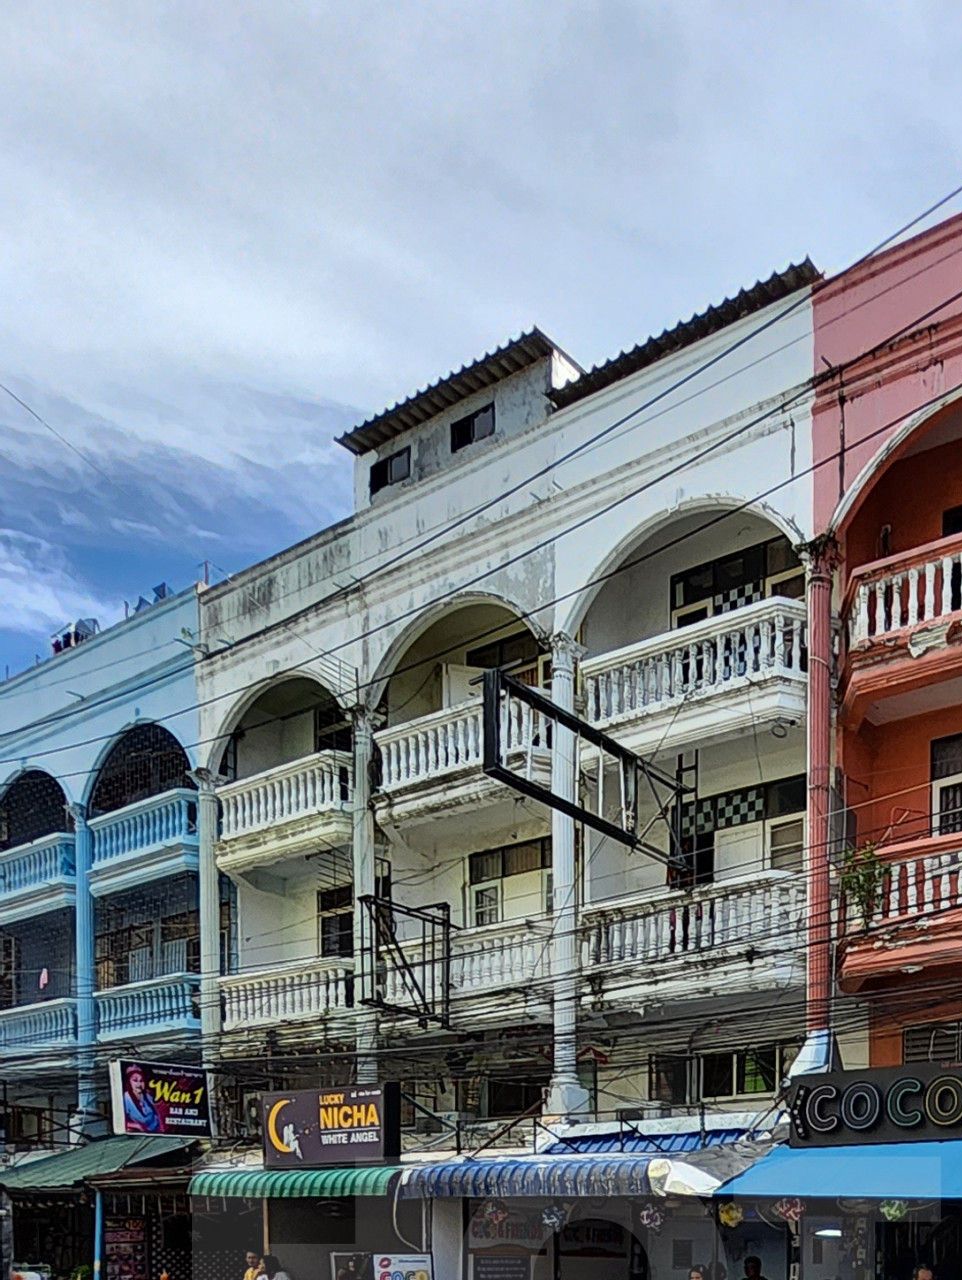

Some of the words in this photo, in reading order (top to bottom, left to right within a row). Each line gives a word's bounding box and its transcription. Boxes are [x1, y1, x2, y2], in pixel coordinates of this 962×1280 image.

[319, 1093, 345, 1105] LUCKY
[319, 1103, 380, 1130] NICHA
[321, 1133, 348, 1145] WHITE
[349, 1131, 380, 1144] ANGEL
